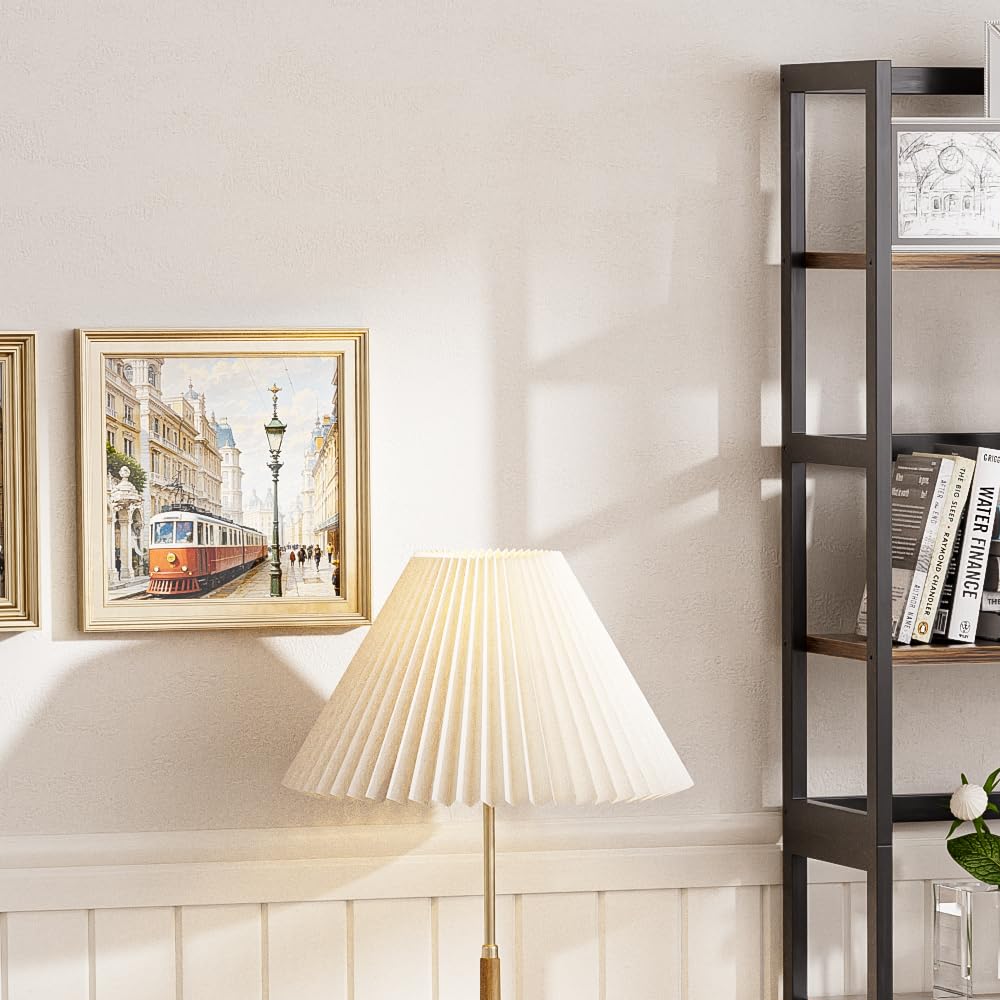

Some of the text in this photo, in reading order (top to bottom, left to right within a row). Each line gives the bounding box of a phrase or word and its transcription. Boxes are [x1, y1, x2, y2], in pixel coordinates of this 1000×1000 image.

[958, 467, 966, 482] THE
[954, 484, 962, 498] BIG
[949, 501, 958, 522] SLEEP
[935, 532, 950, 572] RAYMOND
[962, 487, 995, 600] WATER FINANCE
[924, 574, 940, 616] CHANDLER
